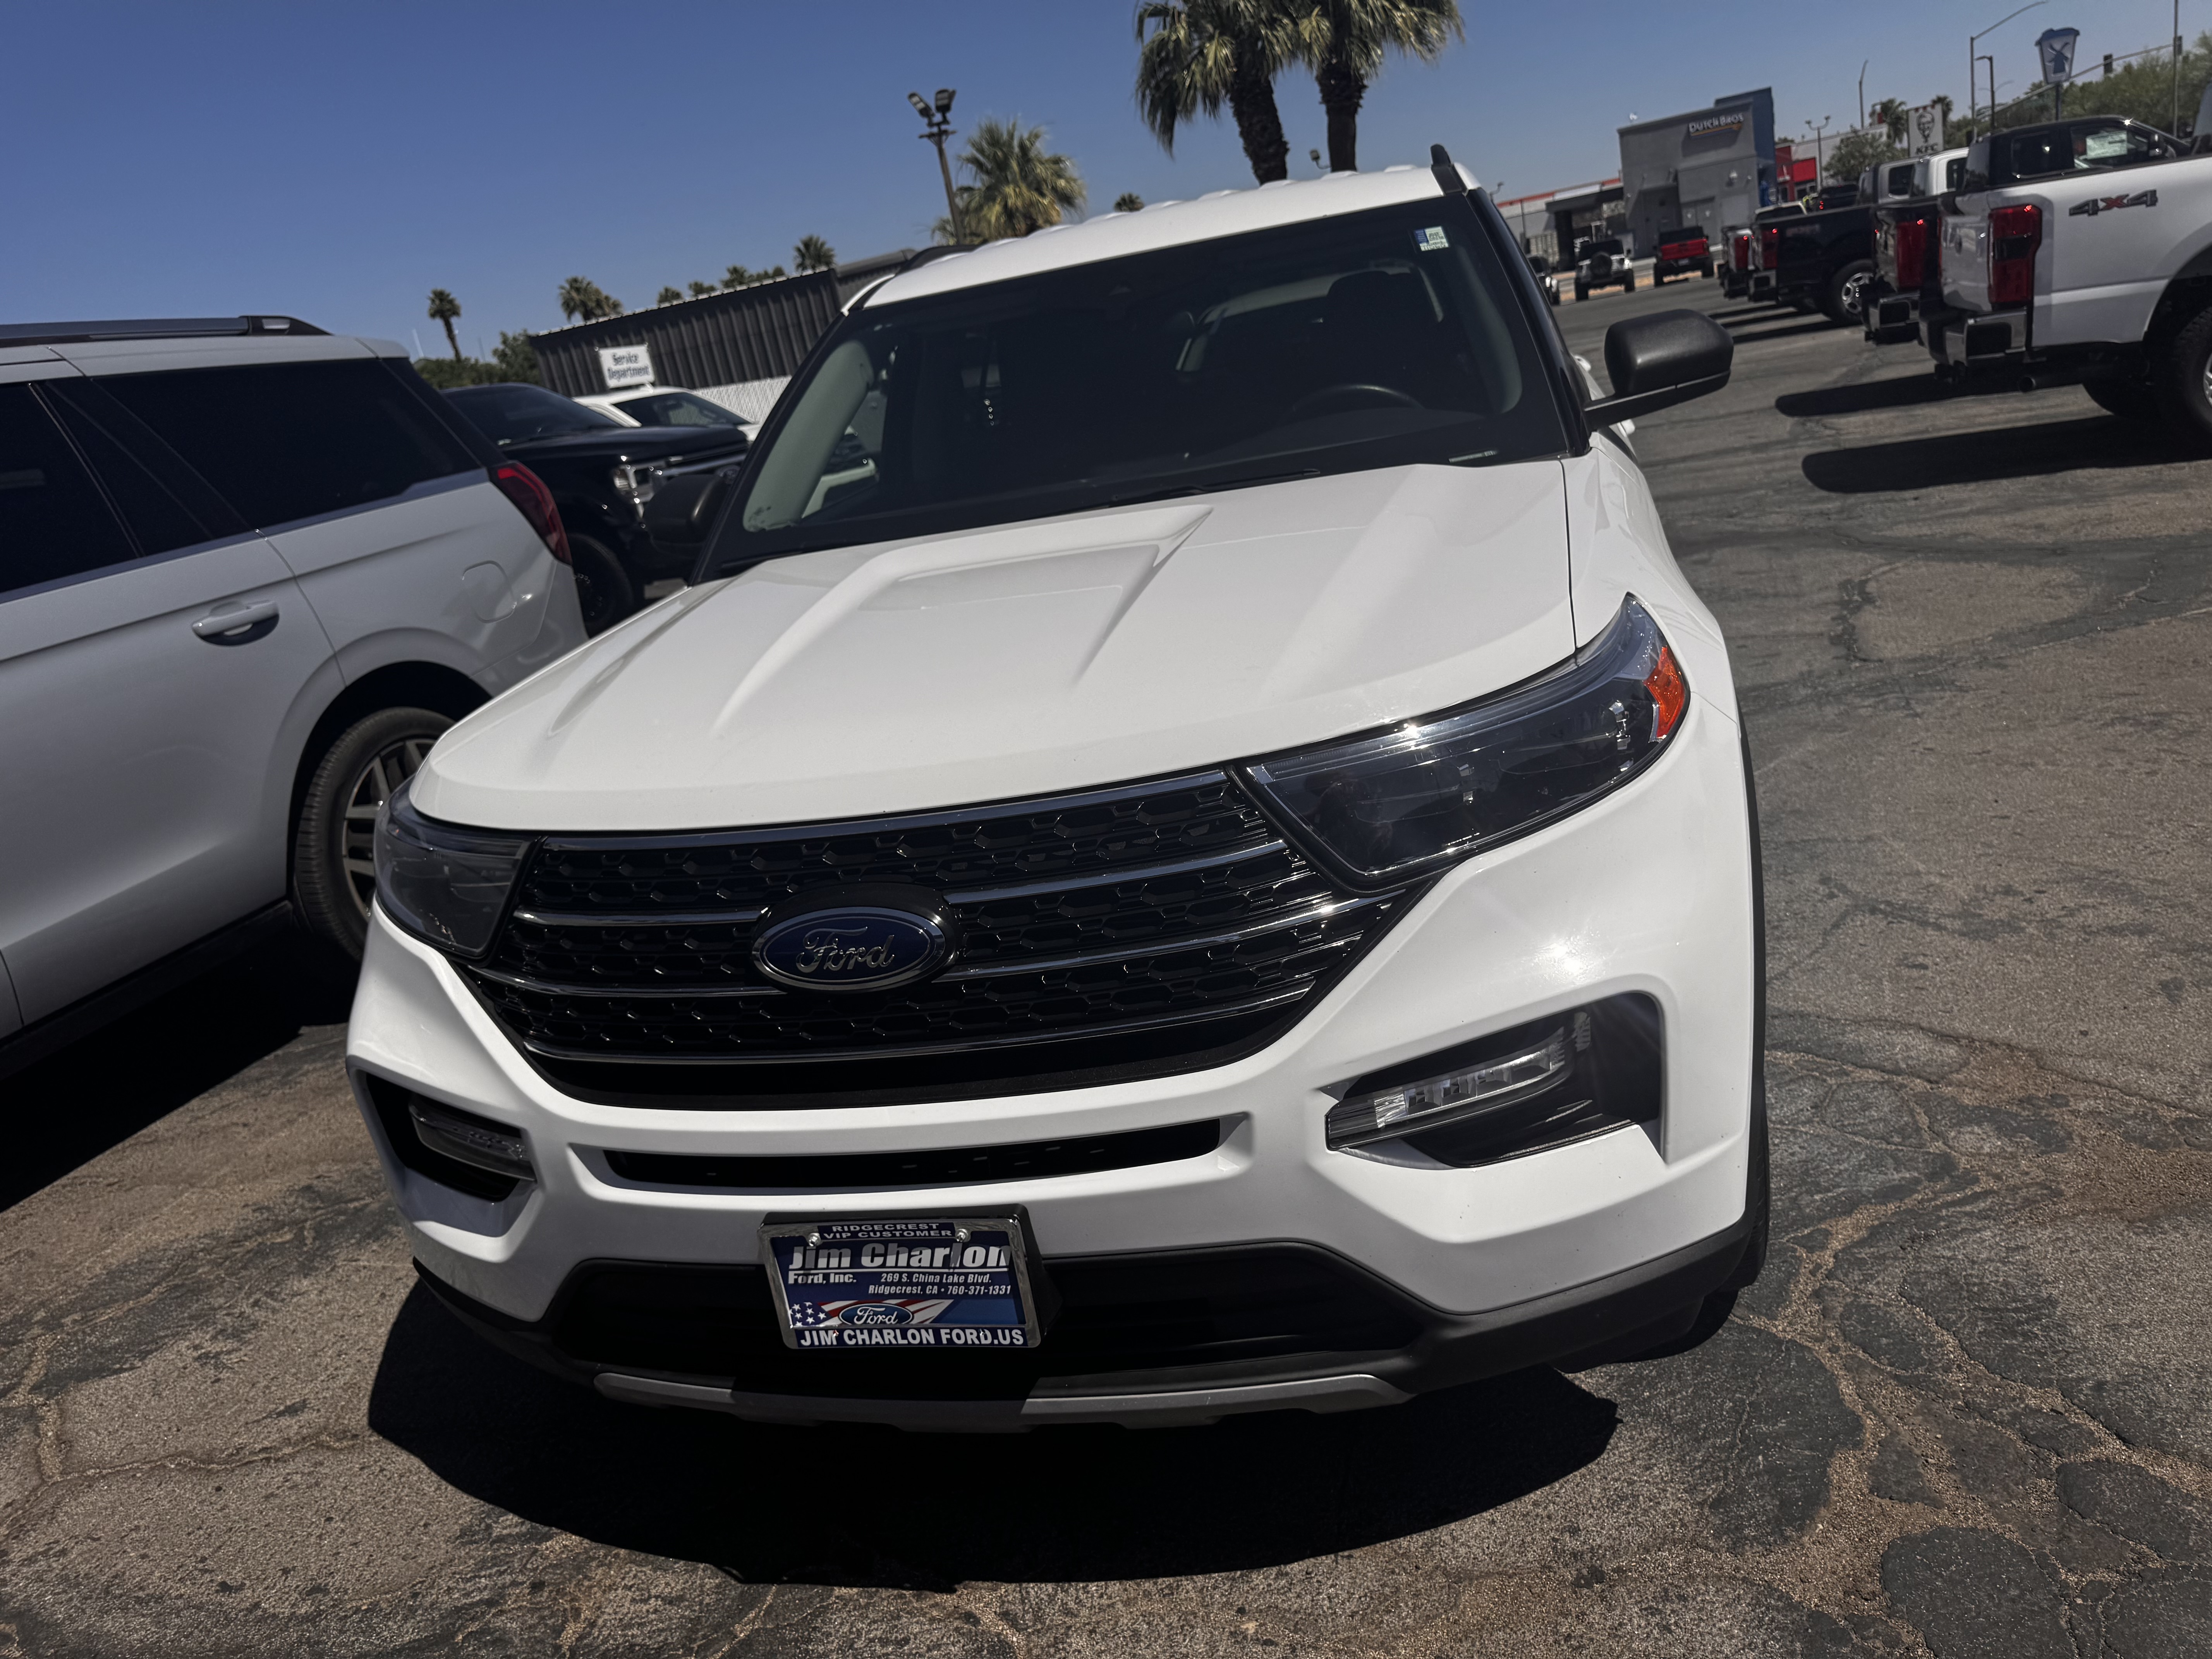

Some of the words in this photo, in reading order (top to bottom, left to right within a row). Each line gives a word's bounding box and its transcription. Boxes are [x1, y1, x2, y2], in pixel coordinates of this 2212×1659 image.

[1915, 142, 1938, 155] KFC
[612, 353, 638, 365] Service
[607, 366, 649, 381] Department
[796, 926, 895, 973] Ford
[789, 1246, 851, 1269] Jim
[861, 1243, 1011, 1267] Charlon
[788, 1271, 826, 1284] Ford,
[830, 1273, 857, 1283] Inc.
[881, 1273, 899, 1282] 269
[902, 1273, 909, 1282] S.
[912, 1273, 940, 1283] China
[943, 1274, 965, 1283] Lake
[967, 1274, 991, 1283] Blvd.
[869, 1285, 923, 1294] Ridgecrest,
[926, 1285, 938, 1294] CA
[947, 1285, 1011, 1295] 760-371-1331
[854, 1307, 898, 1324] Ford
[800, 1330, 837, 1346] JIM
[843, 1329, 935, 1345] CHARLON
[940, 1328, 1024, 1345] FORD.US
